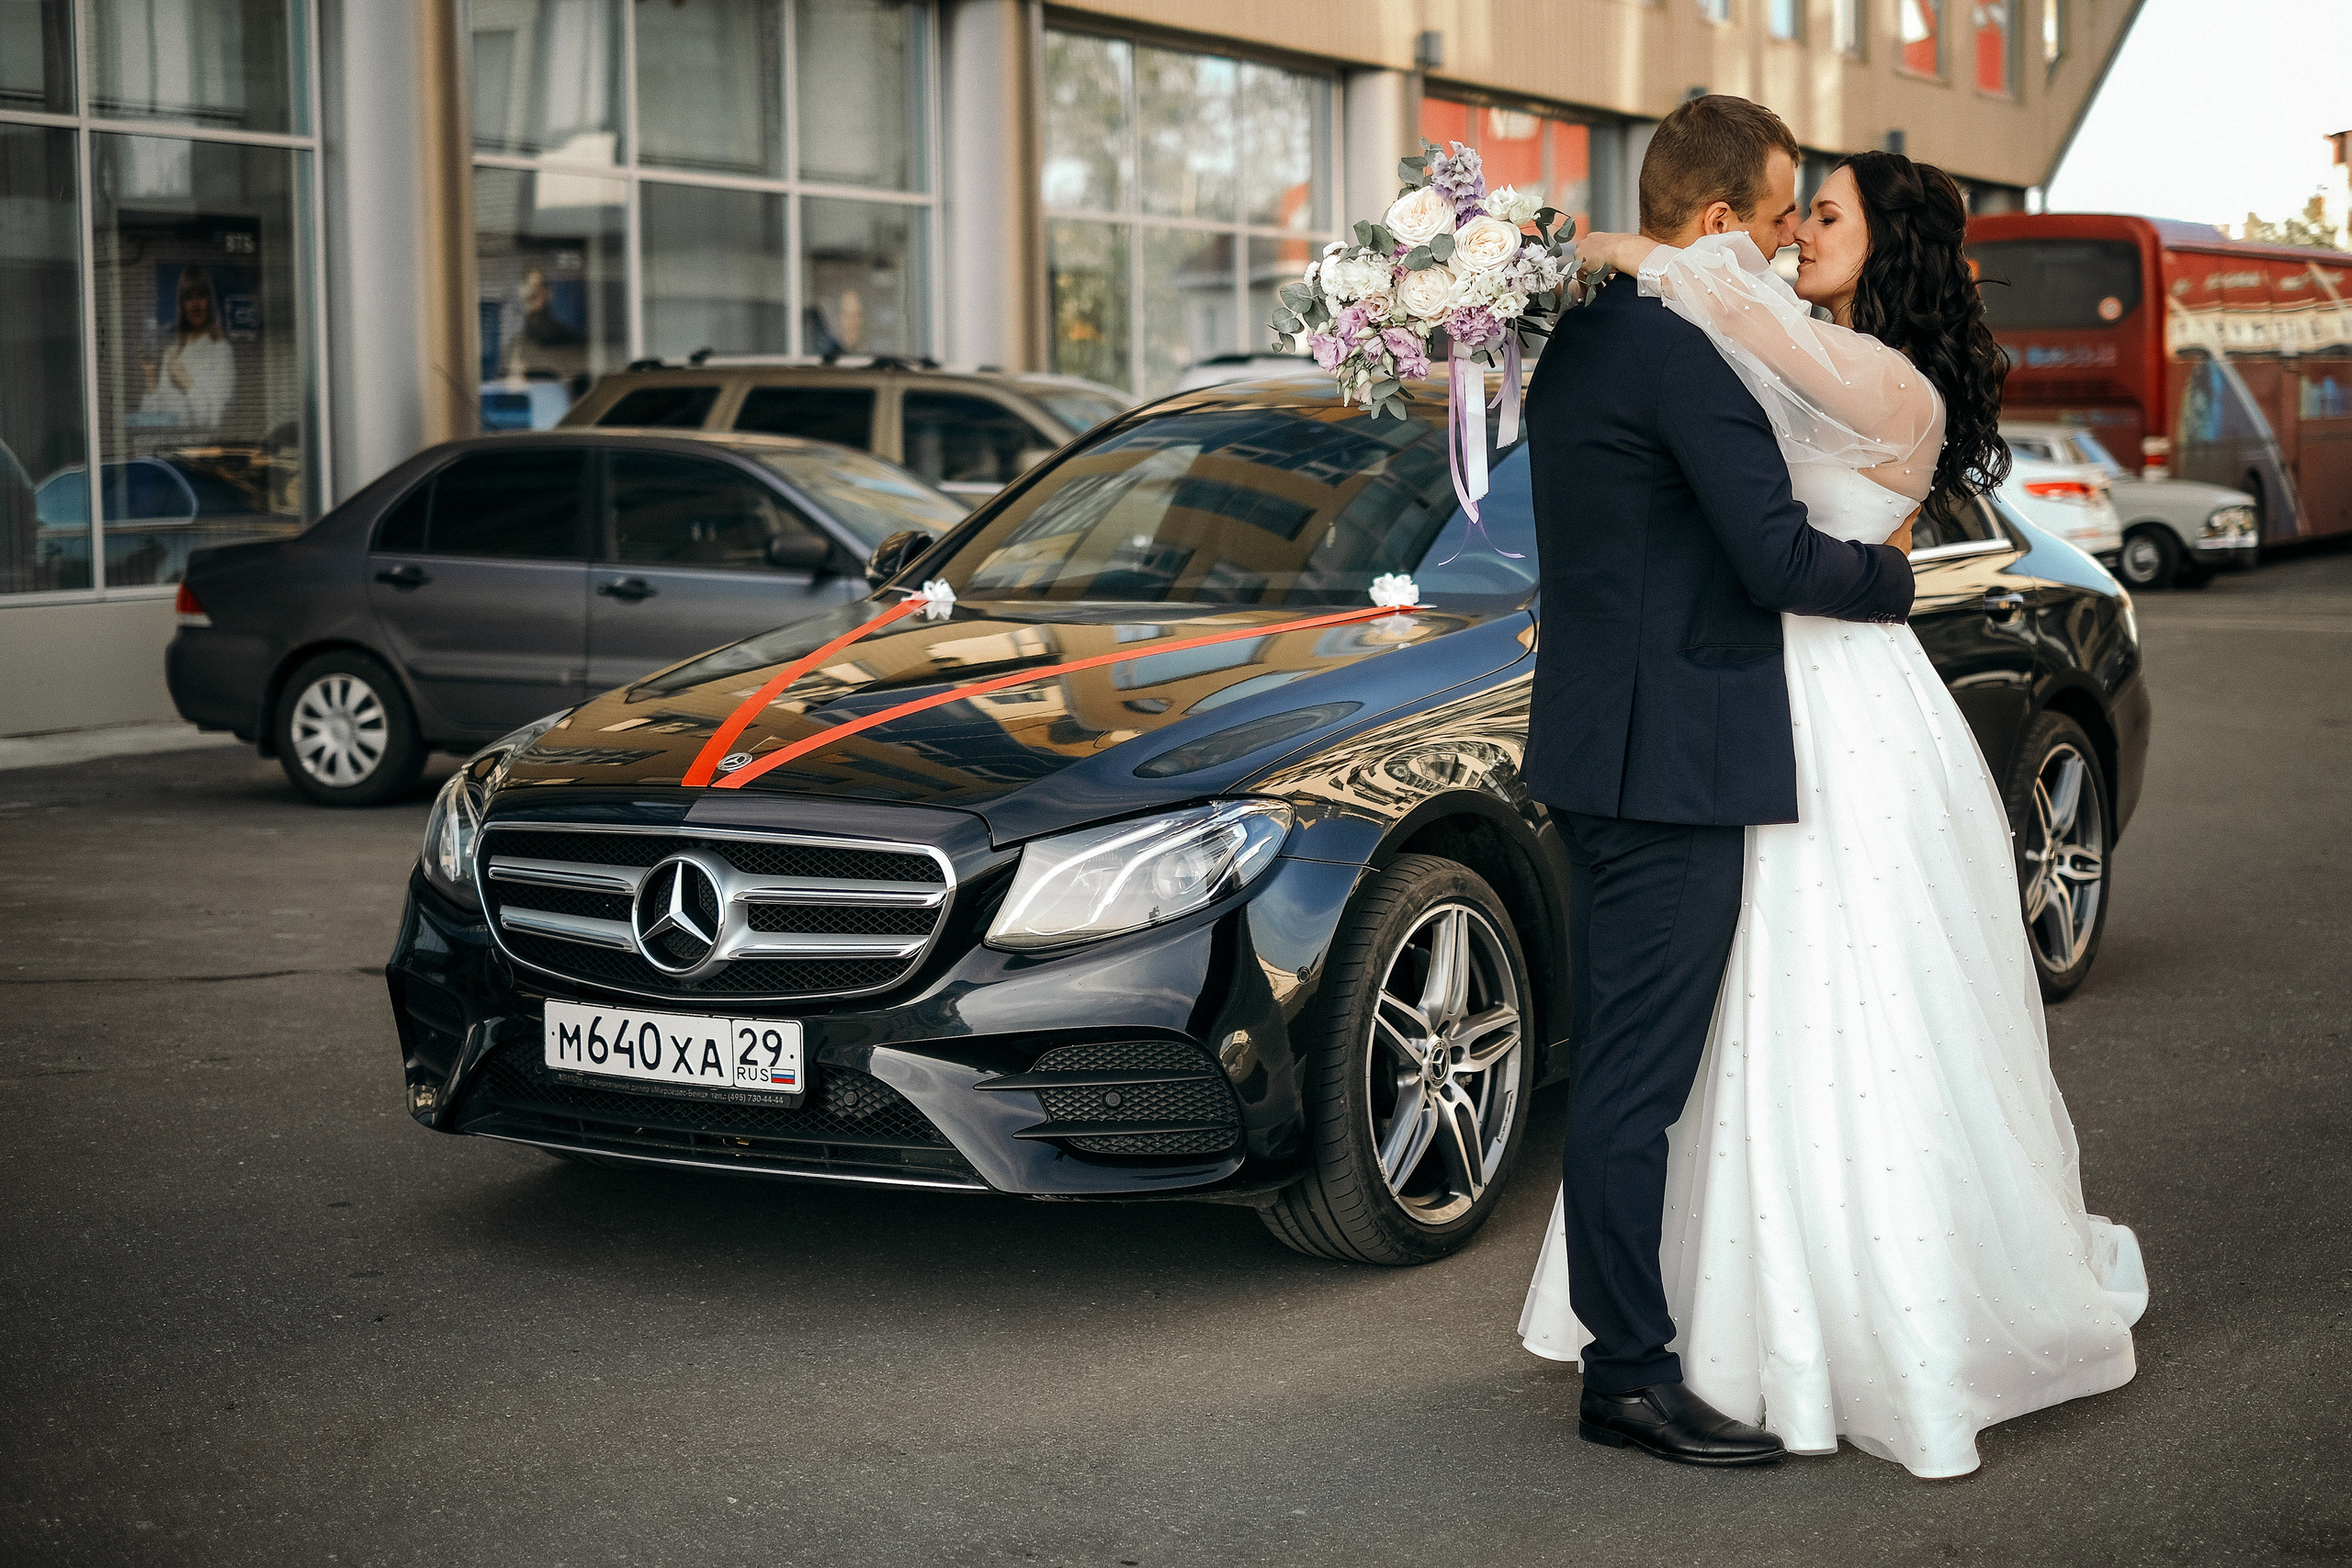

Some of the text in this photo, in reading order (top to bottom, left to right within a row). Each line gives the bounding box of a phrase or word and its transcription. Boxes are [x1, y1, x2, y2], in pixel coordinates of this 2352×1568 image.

[559, 1016, 783, 1077] М640ХА 29
[737, 1066, 769, 1082] RUS
[728, 1093, 746, 1102] (495)
[748, 1094, 784, 1104] 730-44-44
